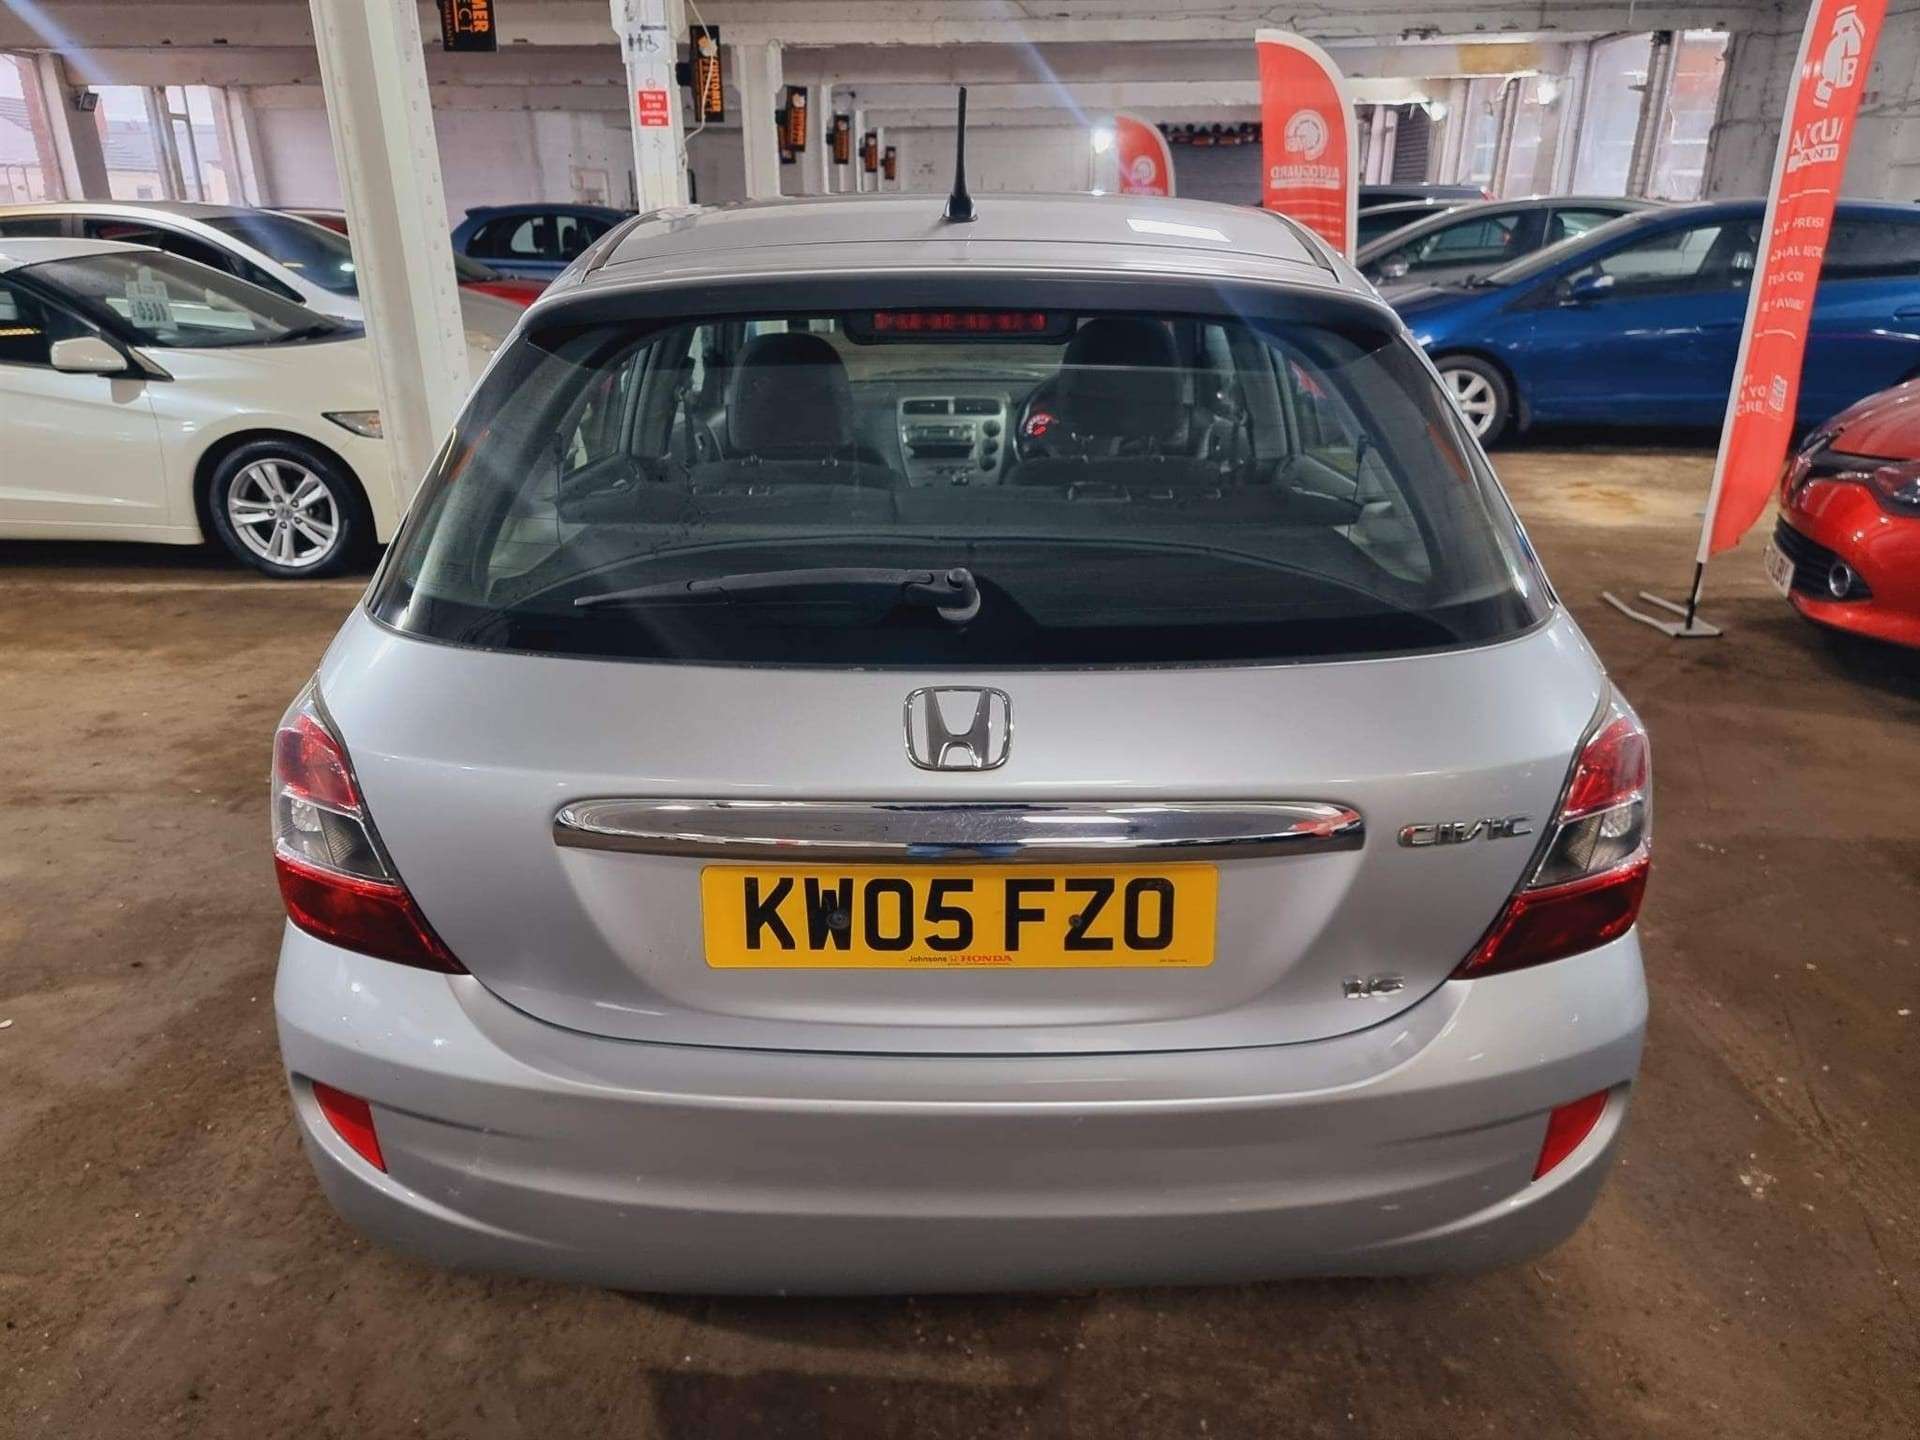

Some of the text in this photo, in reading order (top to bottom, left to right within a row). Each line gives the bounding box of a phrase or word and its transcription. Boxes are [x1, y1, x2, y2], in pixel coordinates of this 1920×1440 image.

[1397, 816, 1535, 848] CIVIC
[744, 877, 1175, 951] KW05 FZO
[908, 954, 1014, 963] Johnsons HONDA
